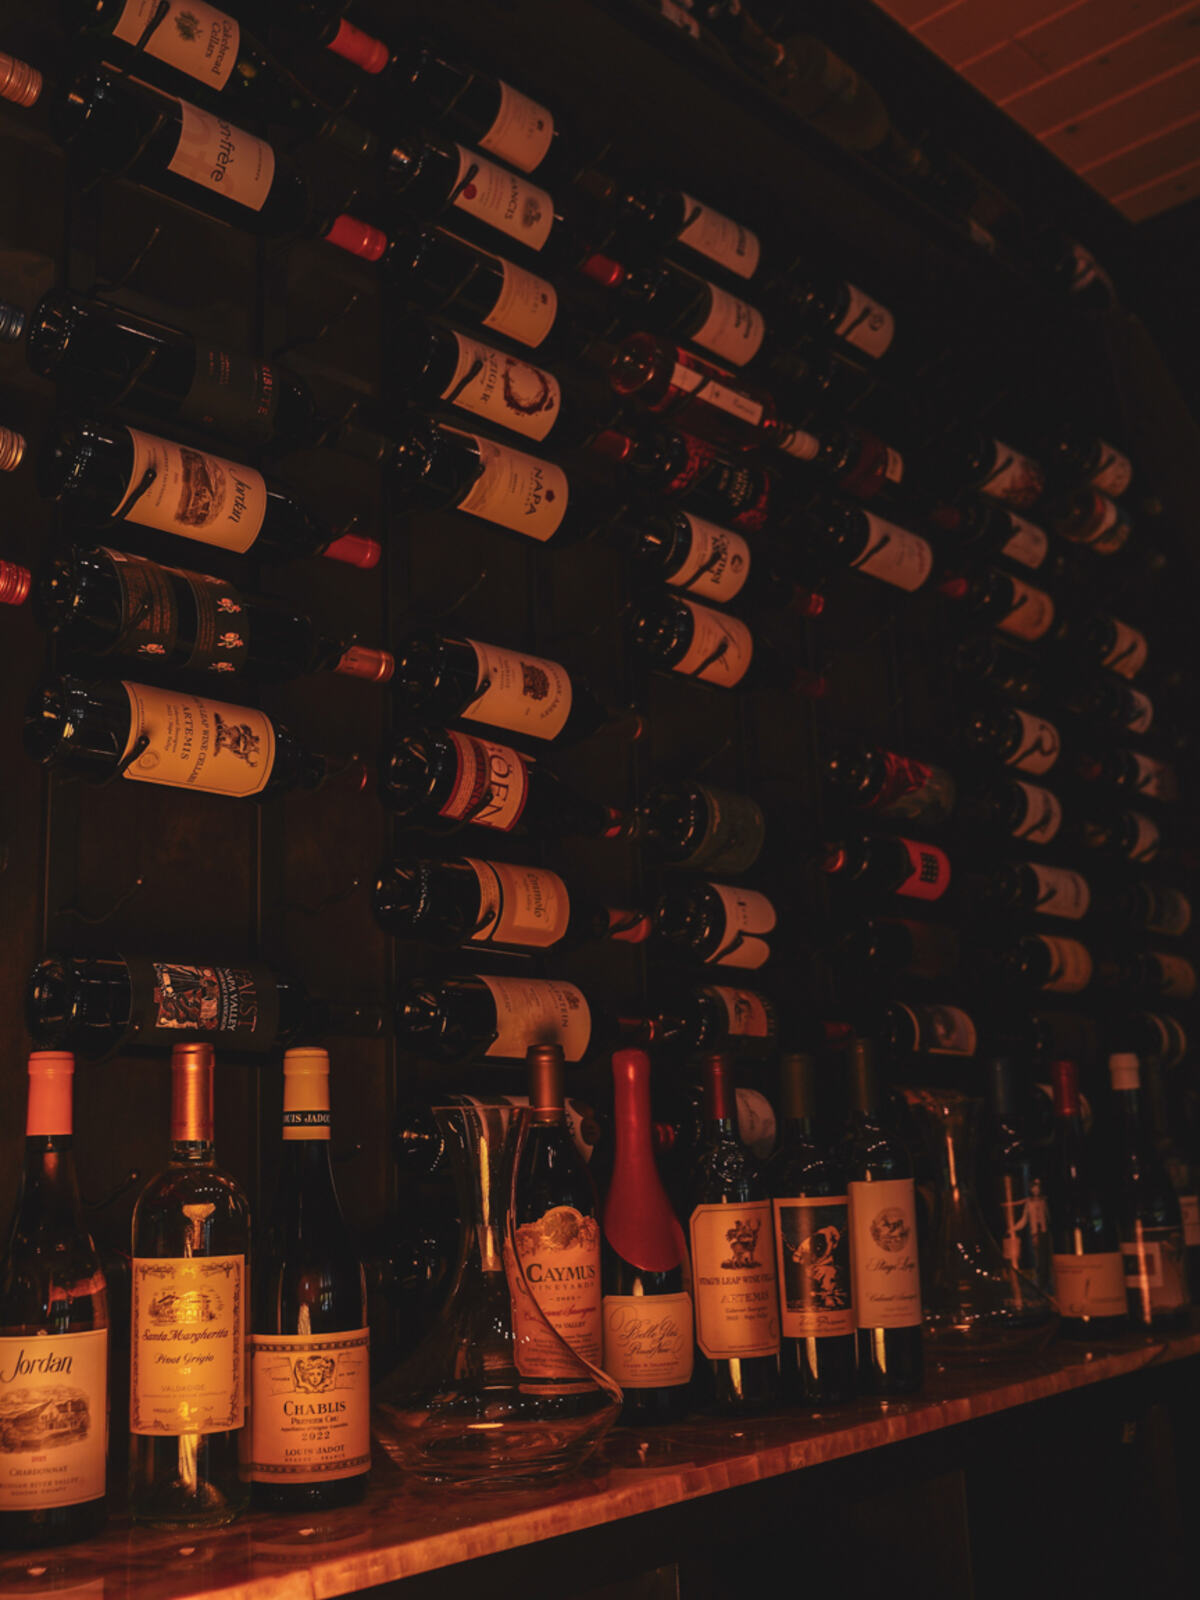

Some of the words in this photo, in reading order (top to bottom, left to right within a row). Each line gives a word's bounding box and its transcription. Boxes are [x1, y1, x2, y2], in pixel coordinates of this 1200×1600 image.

[204, 21, 219, 59] Cellars
[227, 467, 252, 524] Jordan
[523, 465, 544, 516] NAPA
[181, 707, 194, 760] ARTEMIS
[199, 731, 210, 752] WINE
[224, 967, 237, 992] NAPA
[226, 993, 240, 1031] VALLEY
[233, 969, 257, 1032] FAUST
[525, 1263, 596, 1283] CAYMUS
[722, 1275, 741, 1285] LEAP
[142, 1328, 168, 1342] Santa
[167, 1327, 230, 1344] Margherita
[0, 1348, 73, 1384] Jordan
[153, 1353, 181, 1365] Pinot
[183, 1352, 215, 1365] Grigio
[283, 1400, 347, 1417] CHABLIS
[302, 1430, 330, 1441] 2022
[285, 1448, 313, 1457] LOUIS
[317, 1444, 345, 1455] JADOT
